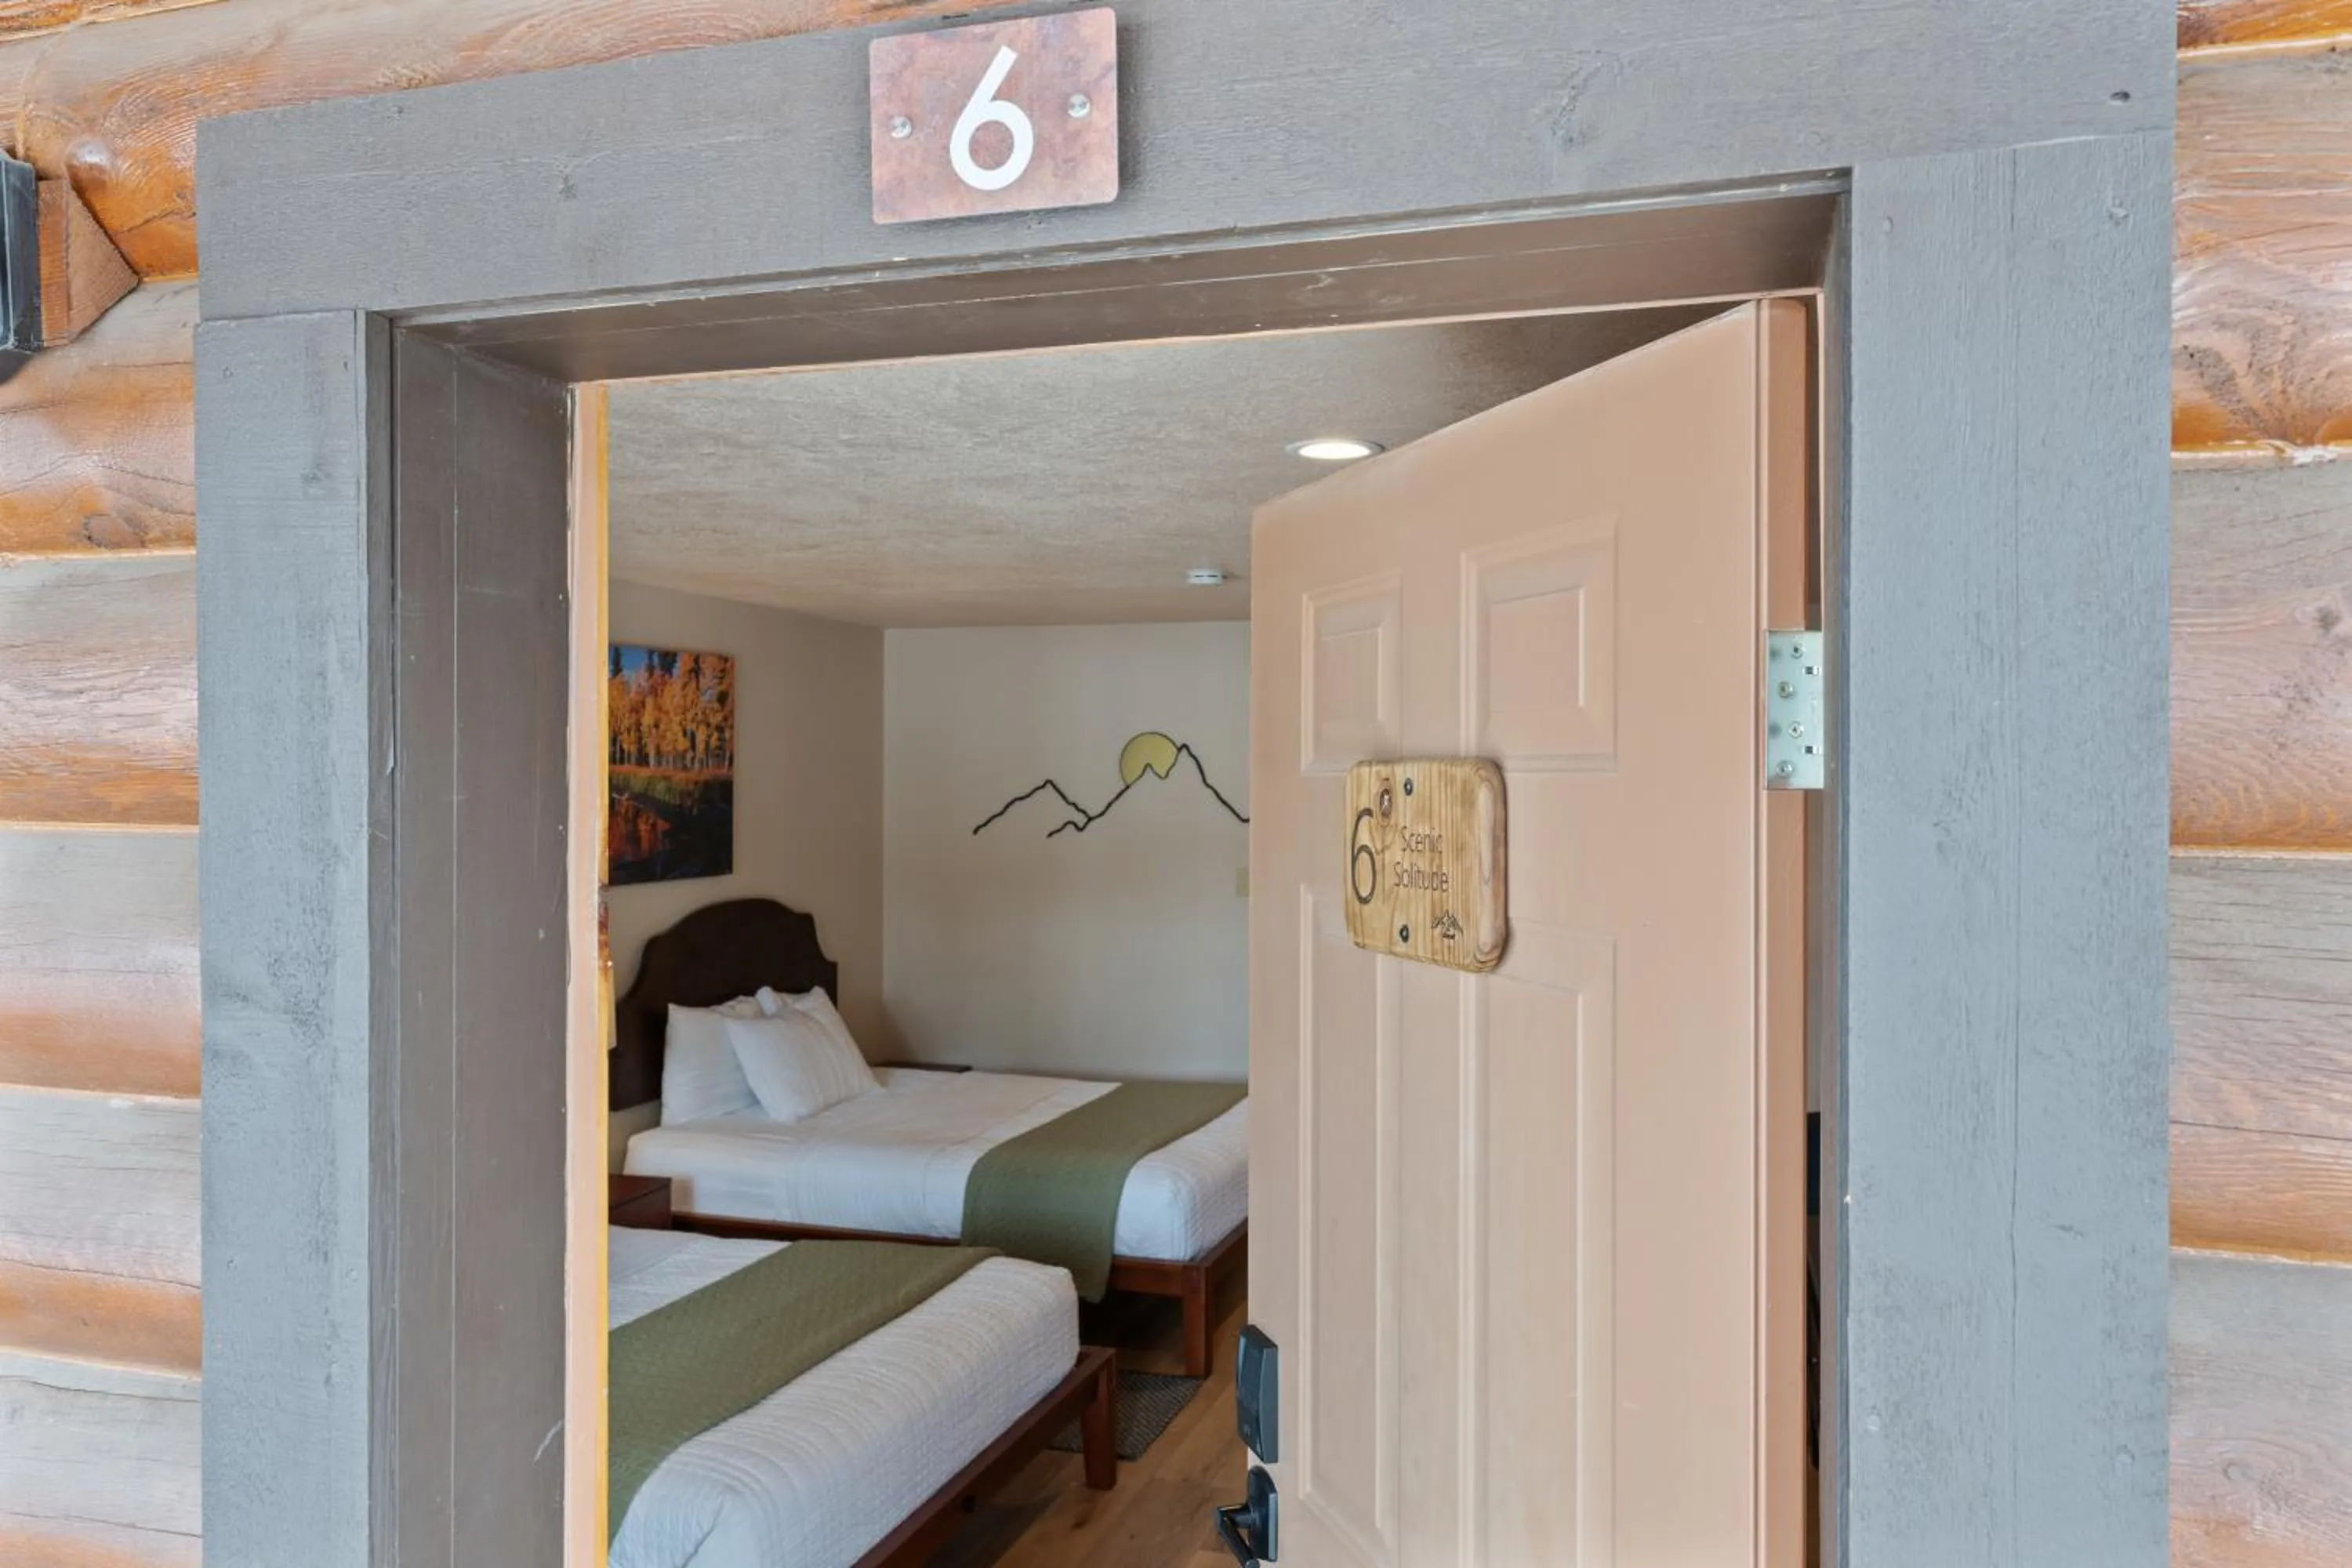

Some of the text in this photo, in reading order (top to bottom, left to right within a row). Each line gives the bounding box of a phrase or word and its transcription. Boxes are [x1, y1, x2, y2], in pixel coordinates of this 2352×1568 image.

[949, 45, 1034, 191] 6
[1351, 807, 1377, 905] 6
[1400, 826, 1443, 855] Scenic
[1393, 861, 1450, 892] Solitude
